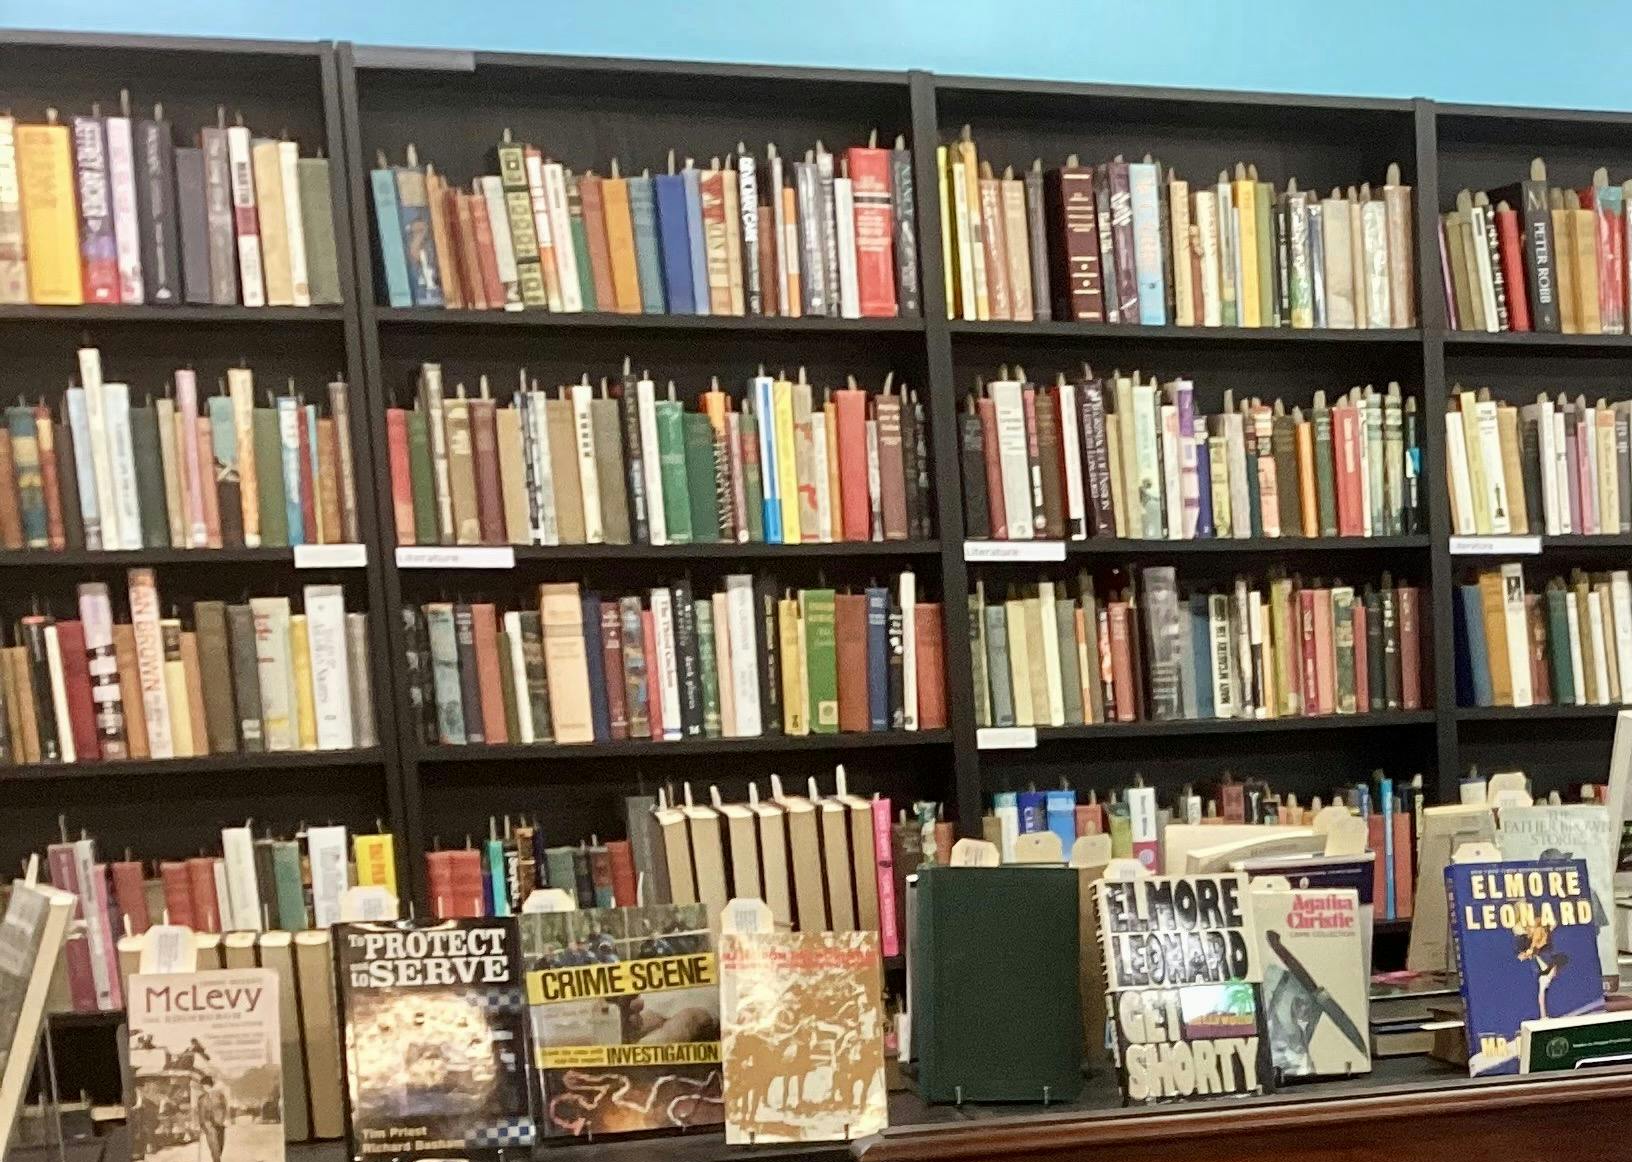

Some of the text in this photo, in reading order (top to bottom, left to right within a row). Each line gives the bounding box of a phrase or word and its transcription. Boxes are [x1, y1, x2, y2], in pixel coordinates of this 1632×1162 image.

[1534, 222, 1551, 304] PETER ROBB
[1470, 870, 1581, 900] ELMORE
[1105, 878, 1243, 932] ELMORE
[1292, 894, 1353, 911] Agatha
[1465, 900, 1592, 930] LEONARD
[1286, 910, 1354, 930] Christie
[364, 928, 506, 959] PROTECT
[1113, 930, 1249, 987] LEONARD
[369, 955, 510, 988] SERVE
[542, 965, 624, 1001] CRIME
[632, 956, 711, 991] SCENE
[146, 984, 264, 1013] McLevy
[1119, 990, 1181, 1044] GET
[607, 1042, 718, 1064] INVESTIGATION
[1126, 1036, 1259, 1100] SHORTY
